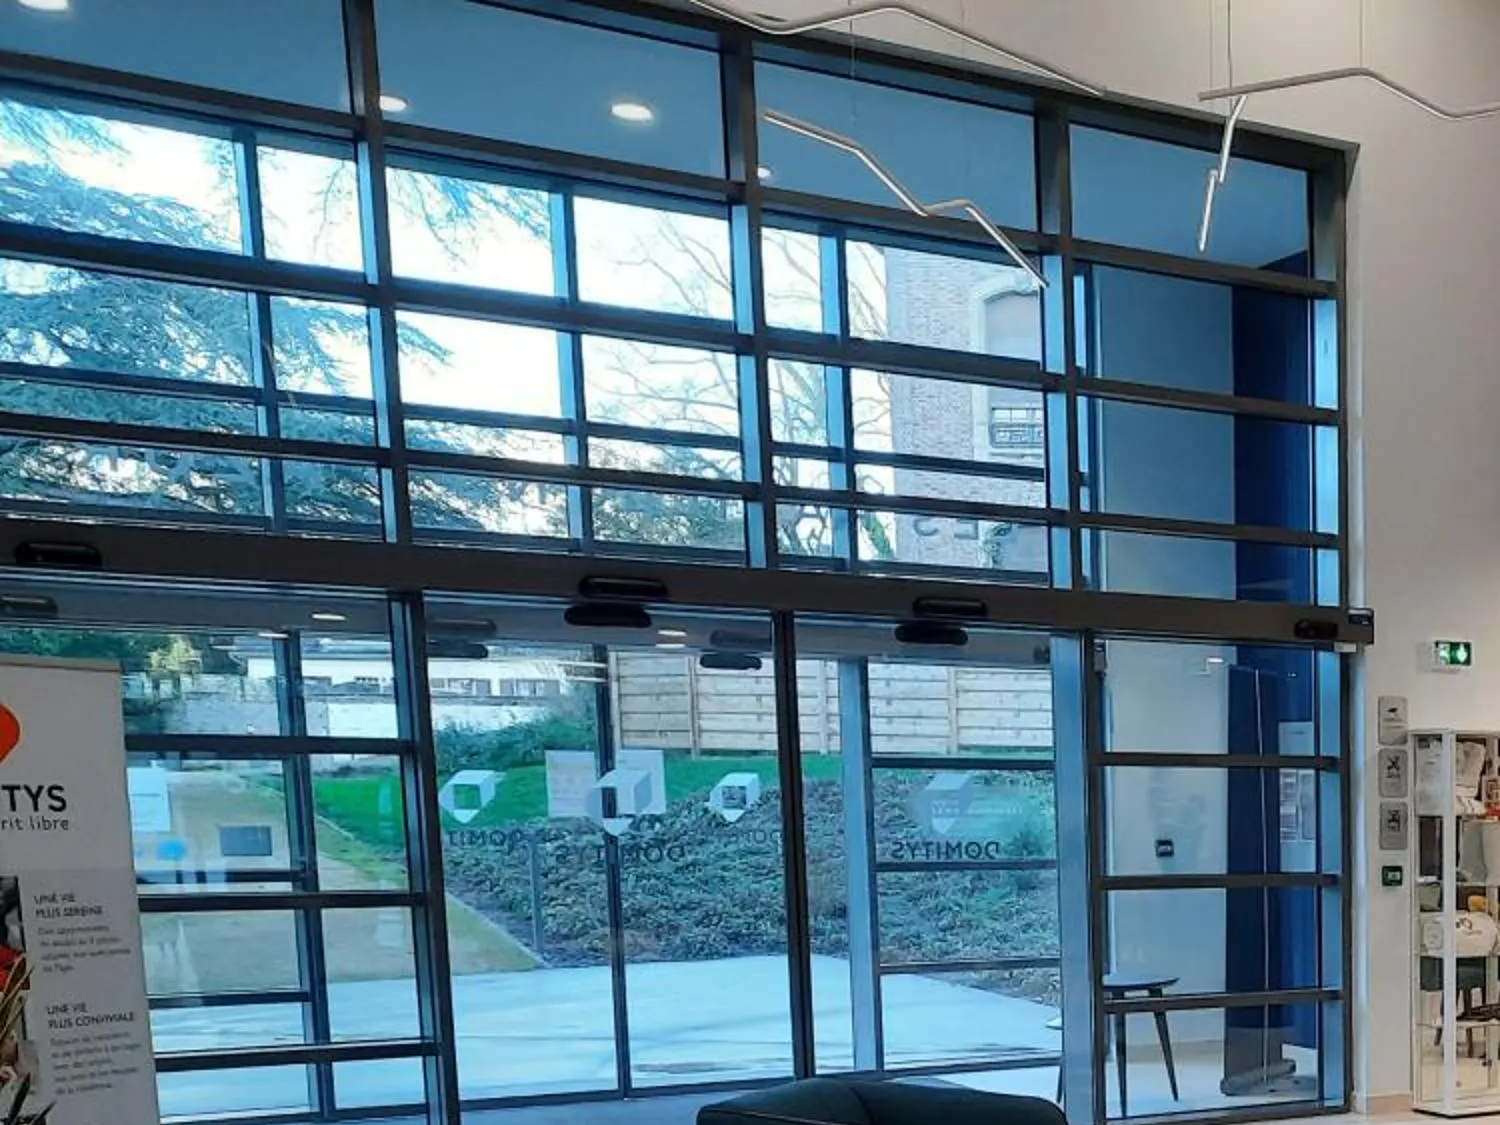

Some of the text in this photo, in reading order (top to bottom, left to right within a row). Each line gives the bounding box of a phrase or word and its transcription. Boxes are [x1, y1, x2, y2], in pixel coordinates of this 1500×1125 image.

[1, 784, 67, 812] TYS
[29, 815, 69, 831] libre
[48, 1018, 73, 1029] PLUS
